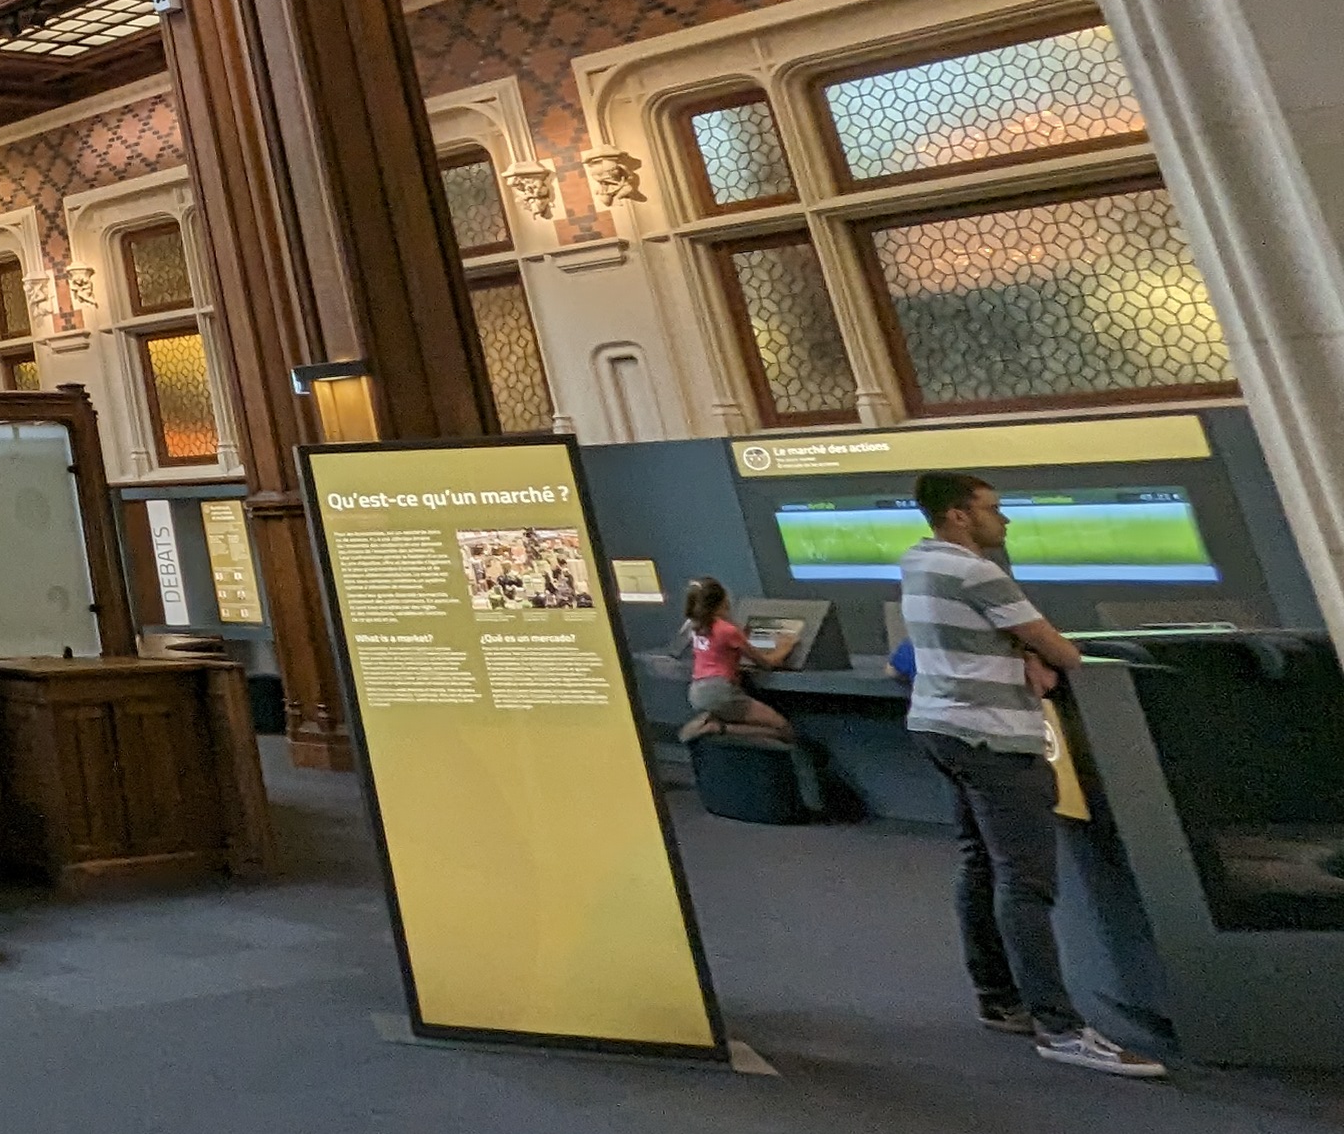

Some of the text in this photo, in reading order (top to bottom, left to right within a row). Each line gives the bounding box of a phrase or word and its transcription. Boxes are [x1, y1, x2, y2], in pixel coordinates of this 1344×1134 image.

[772, 441, 890, 457] Le marché des actions
[327, 485, 570, 511] Qu'est-ce qu'un marché ?
[153, 526, 182, 603] DEBATS
